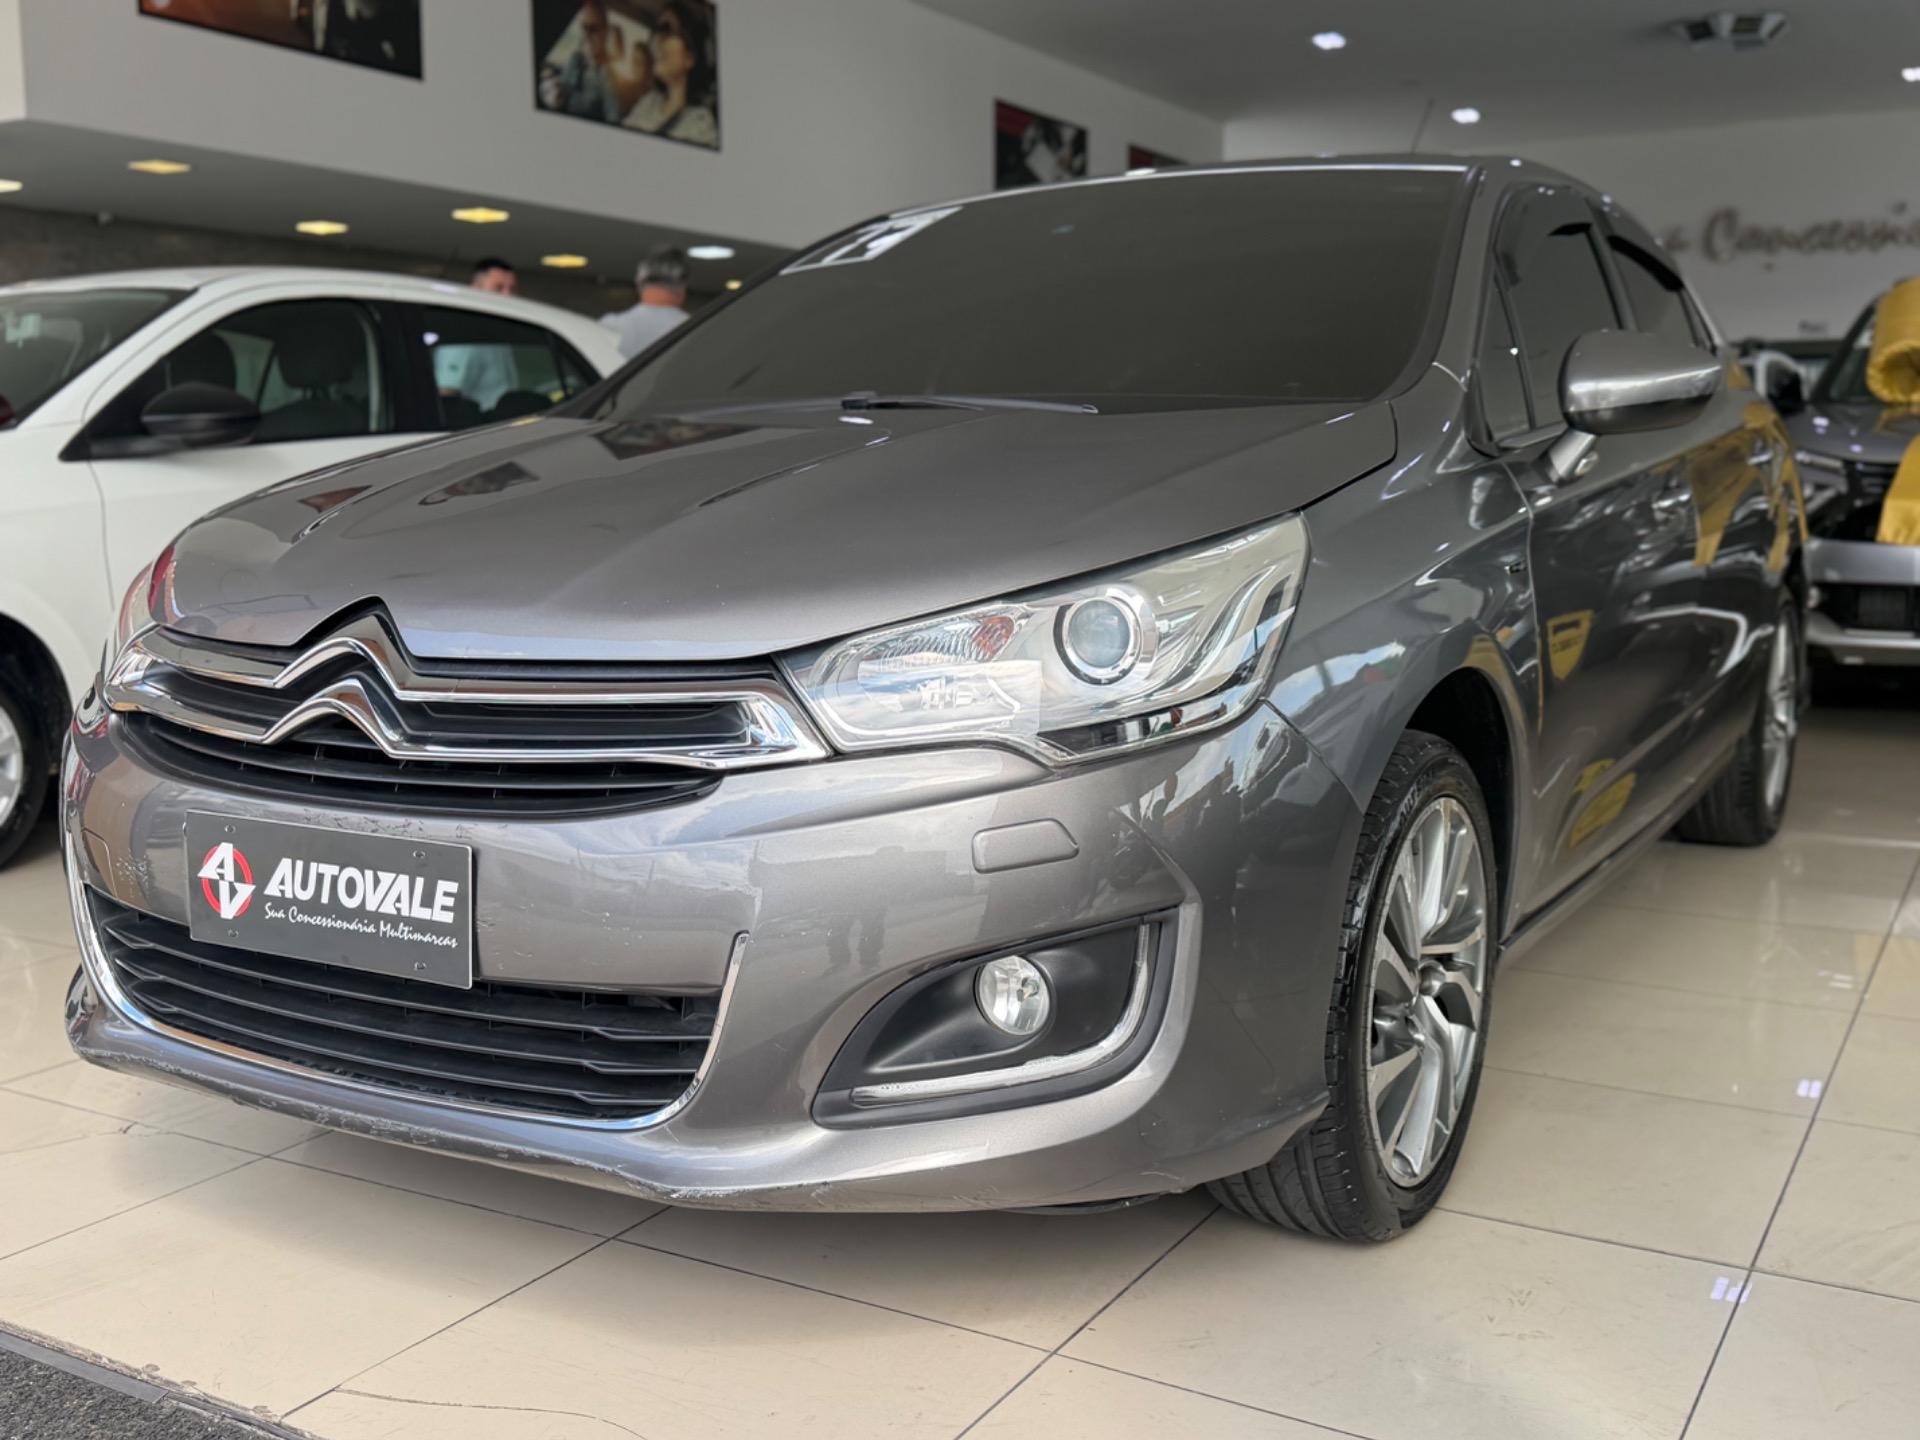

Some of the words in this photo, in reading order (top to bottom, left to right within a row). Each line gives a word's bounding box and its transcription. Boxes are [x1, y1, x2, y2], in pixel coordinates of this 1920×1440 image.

[263, 857, 459, 924] AUTOVALE
[264, 902, 287, 920] Sua
[288, 905, 377, 934] Concessionária
[379, 920, 459, 948] Multimarcas
